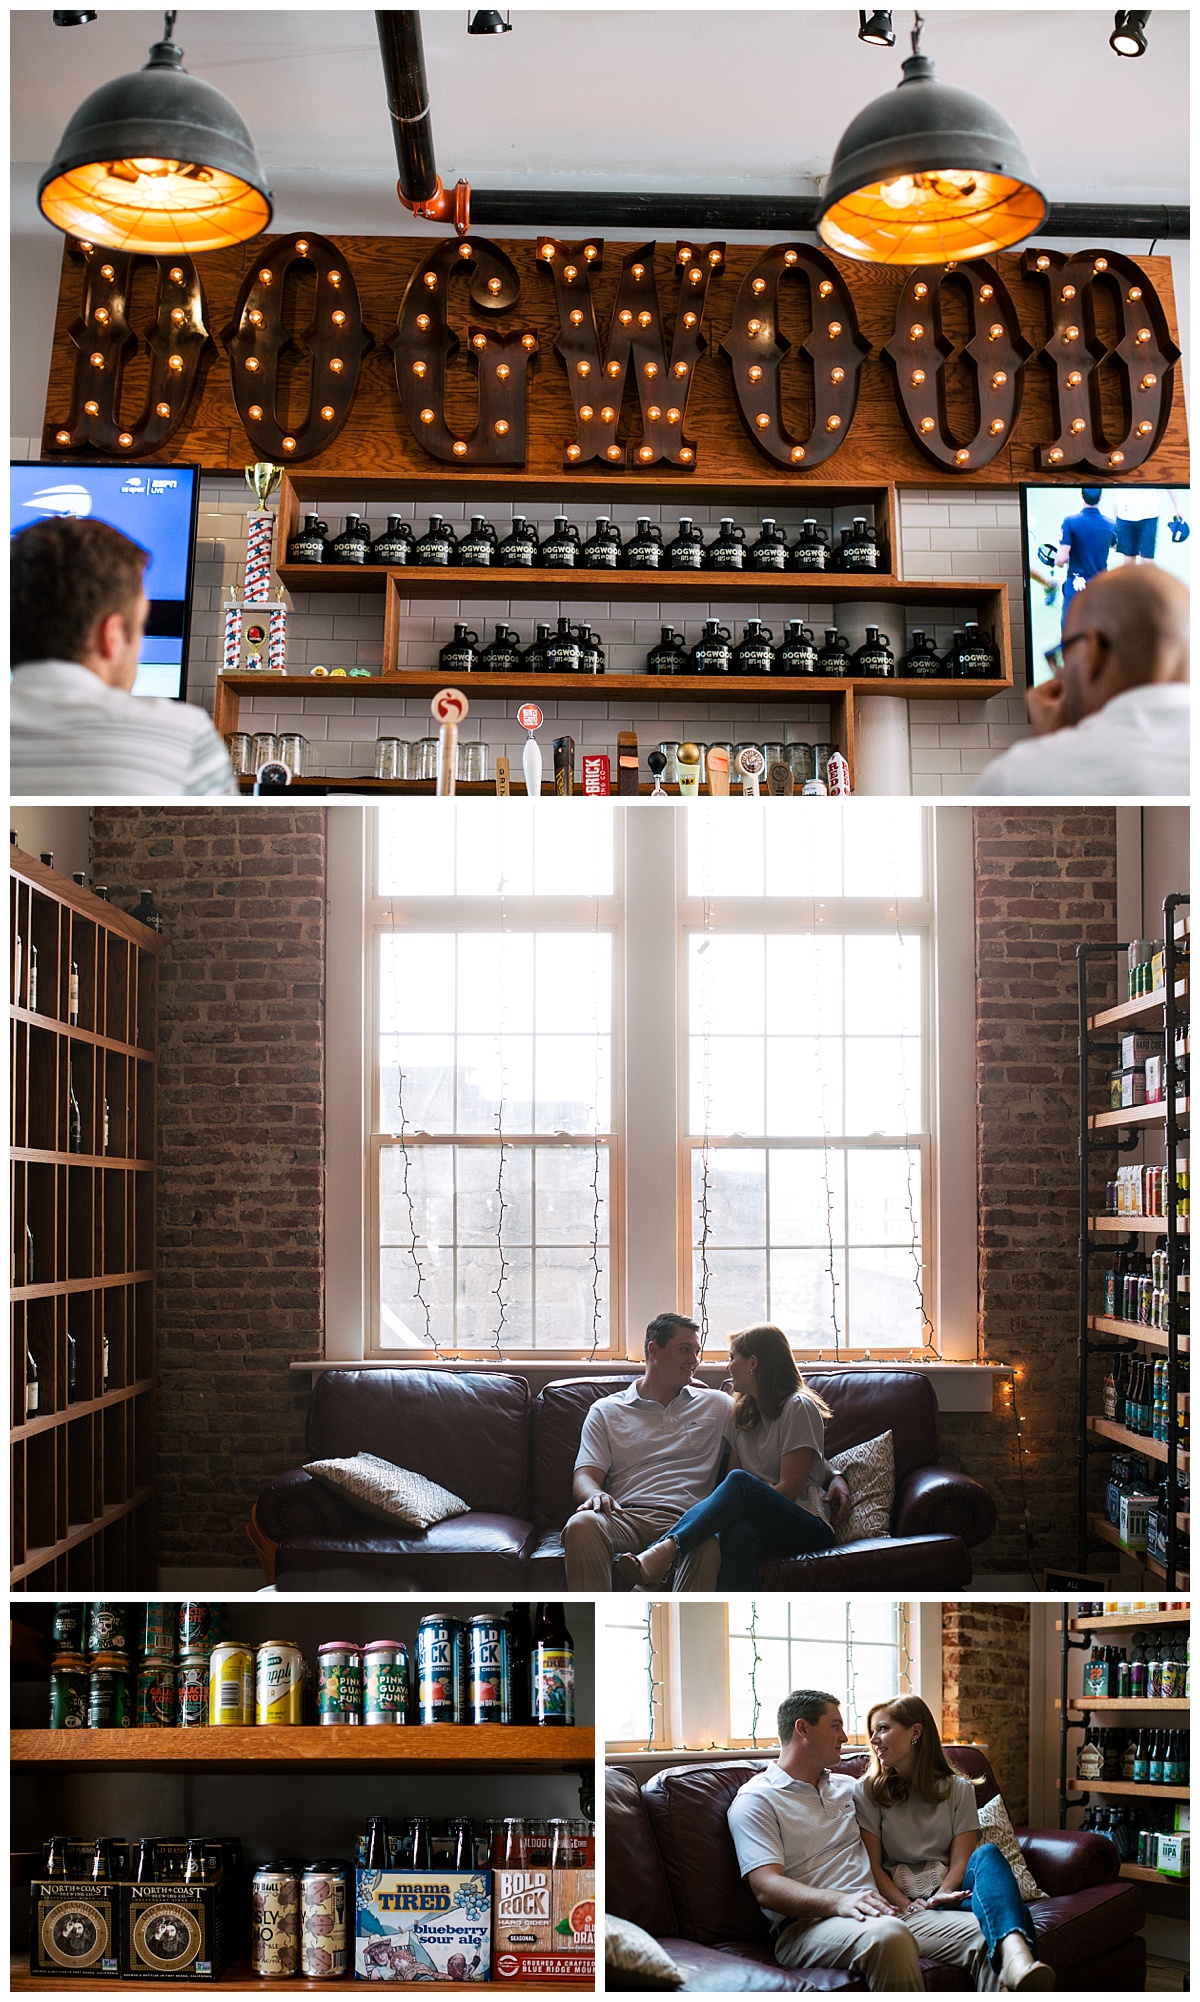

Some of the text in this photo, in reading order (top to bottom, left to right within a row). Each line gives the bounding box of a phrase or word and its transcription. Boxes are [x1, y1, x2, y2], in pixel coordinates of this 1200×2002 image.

[45, 231, 1182, 474] DOGWOOD
[334, 543, 371, 553] DOGWOOD
[374, 543, 412, 554] DOGWOOD
[416, 544, 453, 554] DOGWOOD
[458, 545, 495, 555] DOGWOOD
[500, 545, 538, 555] DOGWOOD
[542, 545, 580, 556] DOGWOOD
[584, 546, 622, 556] DOGWOOD
[628, 547, 664, 557] DOGWOOD
[671, 547, 706, 558] DOGWOOD
[710, 547, 747, 558] DOGWOOD
[753, 548, 790, 559] DOGWOOD
[794, 548, 831, 559] DOGWOOD
[843, 547, 880, 558] DOGWOOD
[442, 654, 479, 663] DOGWOOD
[482, 654, 520, 663] DOGWOOD
[546, 648, 584, 658] DOGWOOD
[816, 658, 850, 668] DOGWOO
[584, 758, 601, 794] BRICK
[828, 761, 839, 788] RED
[1067, 1580, 1079, 1590] ALL
[418, 1629, 448, 1651] BLD
[379, 1676, 403, 1685] PINK
[379, 1685, 409, 1695] GUAVA
[153, 1695, 174, 1704] COYO
[379, 1693, 406, 1703] FUNK
[40, 1884, 111, 1897] NORTH COAST
[396, 1883, 451, 1894] mama
[501, 1873, 546, 1899] BOLD
[131, 1887, 204, 1899] NORTH COAST
[378, 1893, 451, 1911] TIRED
[501, 1891, 546, 1915] ROCK
[412, 1924, 489, 1937] blueberry
[419, 1934, 483, 1945] sour ale
[510, 1934, 535, 1942] SEASONAL
